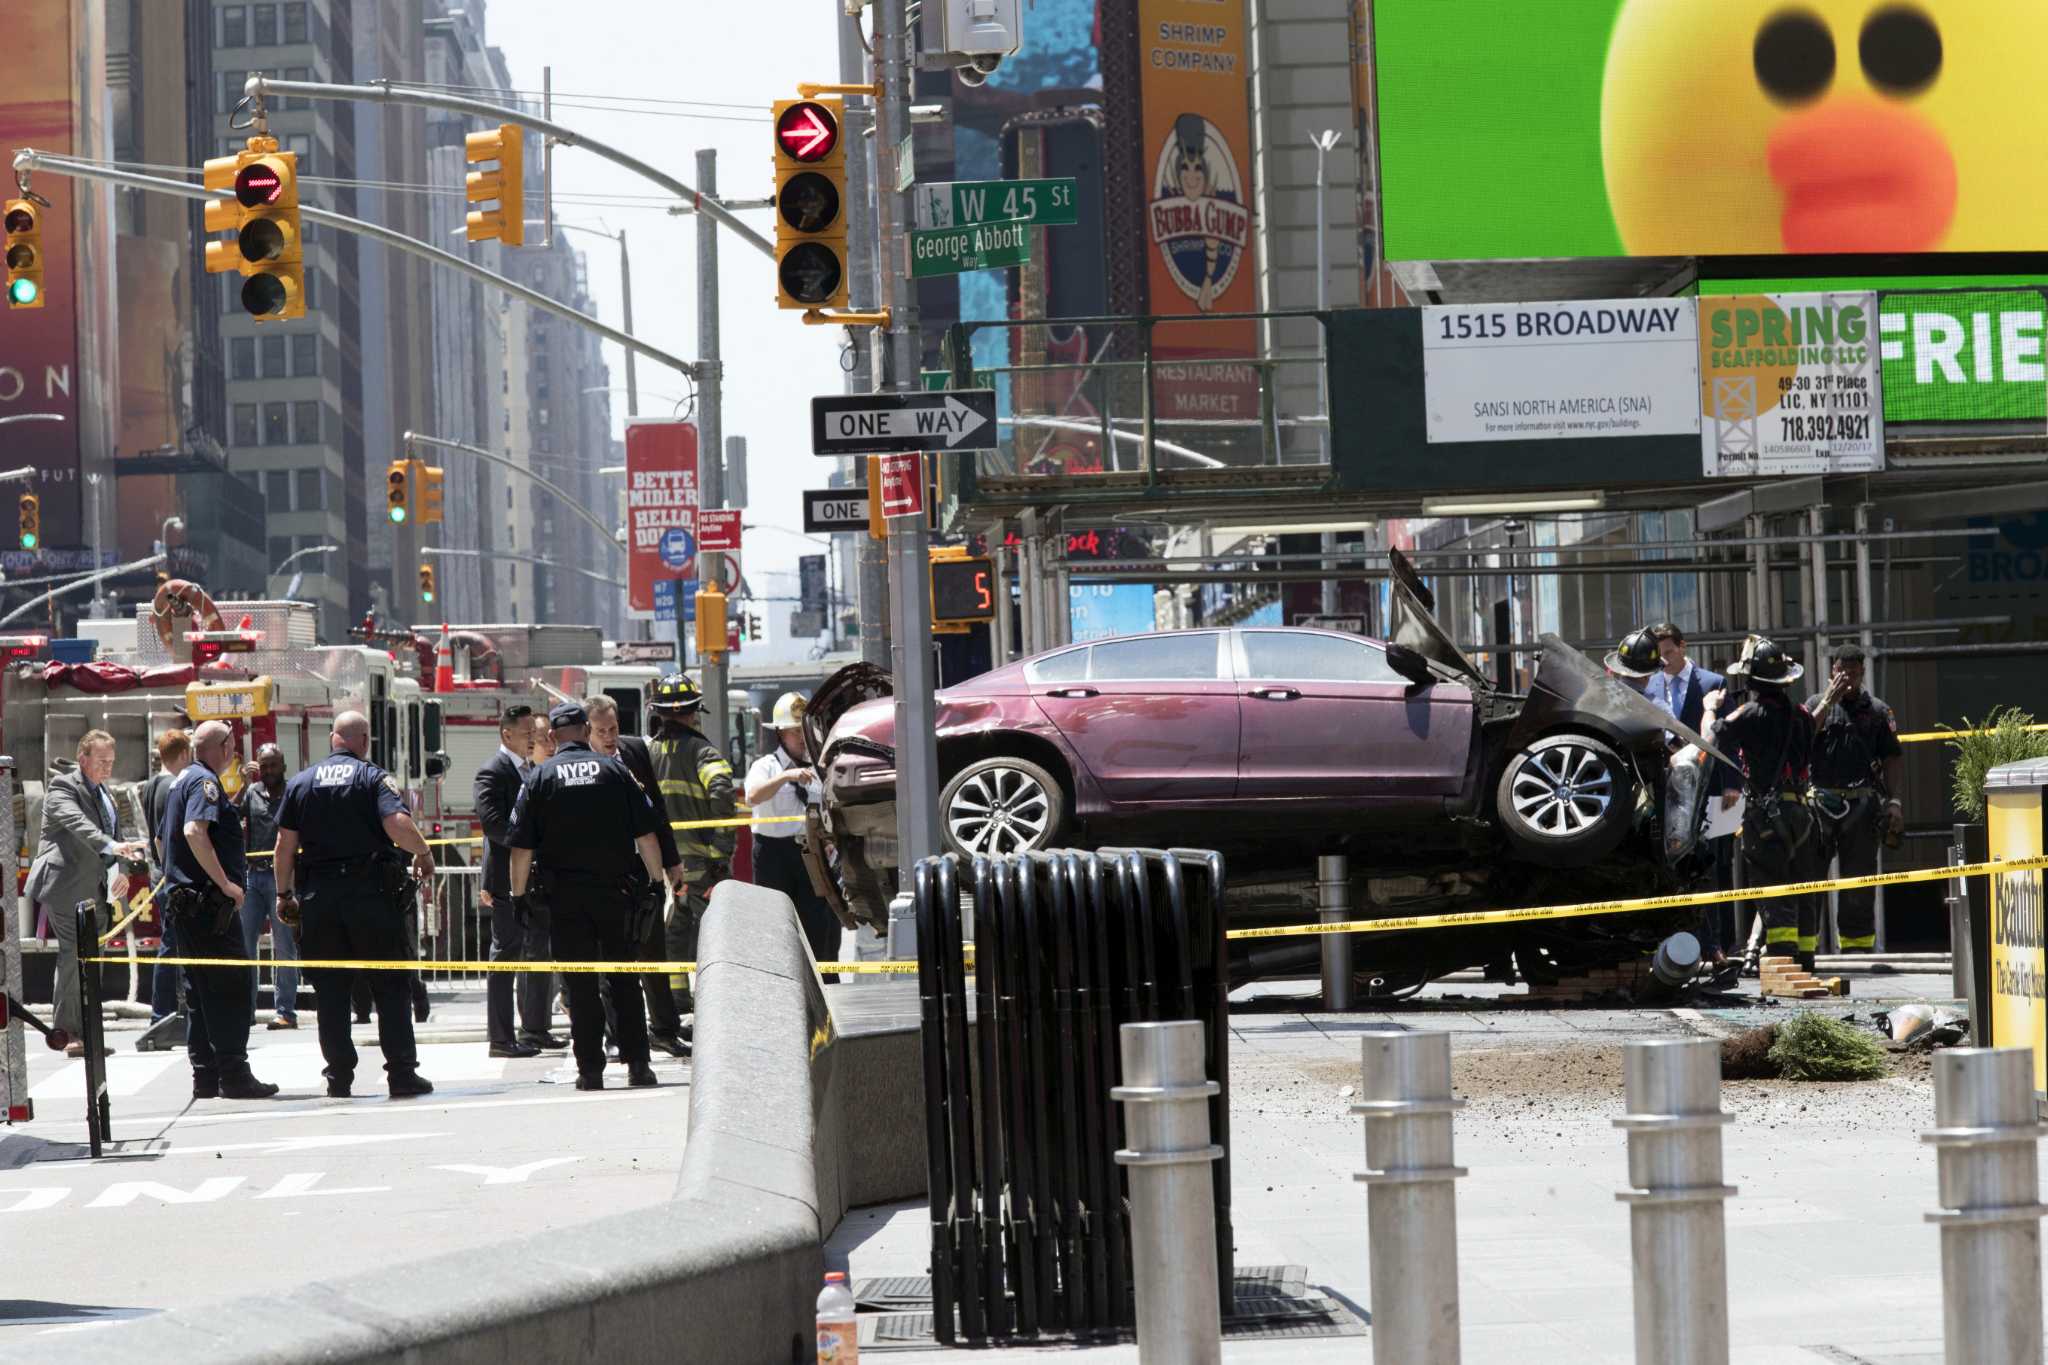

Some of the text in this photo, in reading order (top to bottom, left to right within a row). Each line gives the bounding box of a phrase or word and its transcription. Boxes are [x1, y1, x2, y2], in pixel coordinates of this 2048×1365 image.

[1159, 23, 1227, 44] SHRIMP
[1151, 48, 1235, 72] COMPANY
[959, 185, 1071, 222] W 45 St
[1153, 201, 1246, 241] BUBBA GUMP
[916, 223, 1024, 261] George Abbott
[962, 255, 979, 268] Way
[1440, 307, 1680, 340] 1515 BROADWAY
[1711, 304, 1867, 348] SPRING
[1711, 346, 1867, 368] SCAFFOLDING LLC
[1880, 311, 2045, 384] FRIE
[1156, 365, 1253, 384] RESTAURANT
[1778, 376, 1810, 390] 49-30
[1836, 376, 1867, 389] Place
[1174, 394, 1240, 413] MARKET
[1473, 394, 1652, 418] SANSI NORTH AMERICA (SNA)
[1810, 393, 1826, 408] NY
[1833, 391, 1868, 408] 11101
[839, 409, 969, 437] ONE WAY
[1514, 421, 1552, 432] information
[1781, 414, 1870, 442] 718.392.4921
[632, 470, 694, 489] BETTE
[628, 488, 697, 507] MIDLER
[822, 501, 860, 520] ONE
[1967, 551, 2048, 584] BRO
[974, 572, 990, 609] 5
[315, 764, 354, 780] NYPD
[556, 760, 601, 779] NYPD
